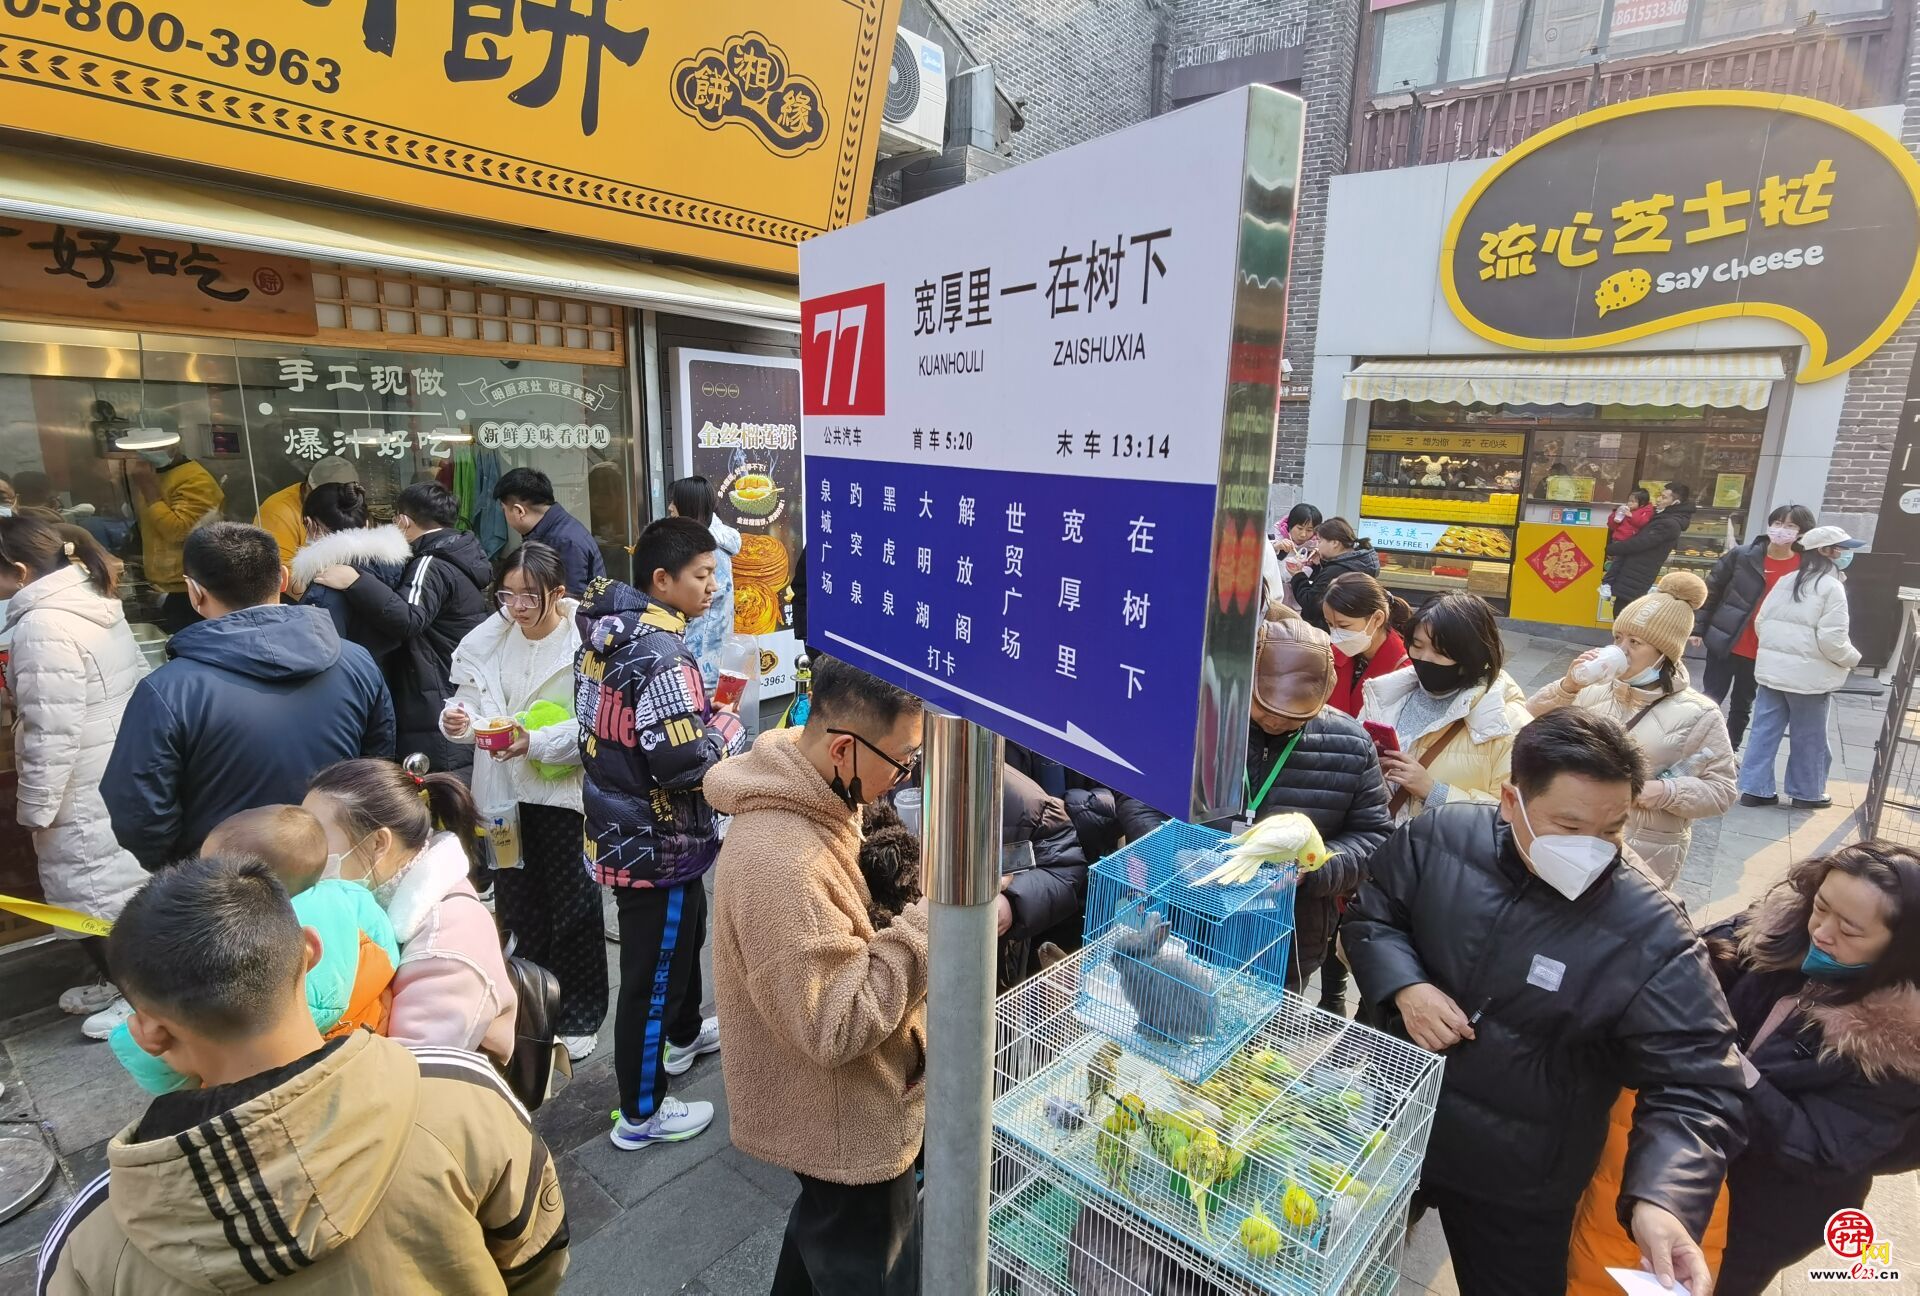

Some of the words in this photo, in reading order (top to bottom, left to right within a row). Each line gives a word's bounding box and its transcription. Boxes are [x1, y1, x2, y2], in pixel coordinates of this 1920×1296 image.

[1478, 160, 1837, 281] 流心芝士挞
[0, 224, 250, 302] 好吃
[1712, 244, 1825, 283] cheese
[278, 359, 447, 397] 手工现做
[812, 304, 868, 406] 77
[918, 350, 984, 376] KUANHOULI
[1053, 332, 1147, 367] ZAISHUXIA
[284, 427, 452, 460] 爆汁好吃
[483, 425, 608, 445] 新鲜美味看得见
[823, 426, 863, 448] 公共汽车
[945, 431, 973, 451] 5:20
[1111, 433, 1170, 459] 13:14
[820, 478, 833, 596] 泉城广场
[850, 482, 863, 605] 趵突泉
[882, 486, 896, 616] 黑虎泉
[916, 490, 933, 630] 大明湖
[1378, 526, 1433, 540] 买五送一
[1403, 540, 1422, 548] FREE
[955, 495, 976, 645] 解放阁
[1001, 502, 1026, 660] 世贸广场
[1055, 508, 1086, 680] 宽厚里
[1119, 515, 1157, 700] 在树下
[927, 645, 956, 677] 打卡
